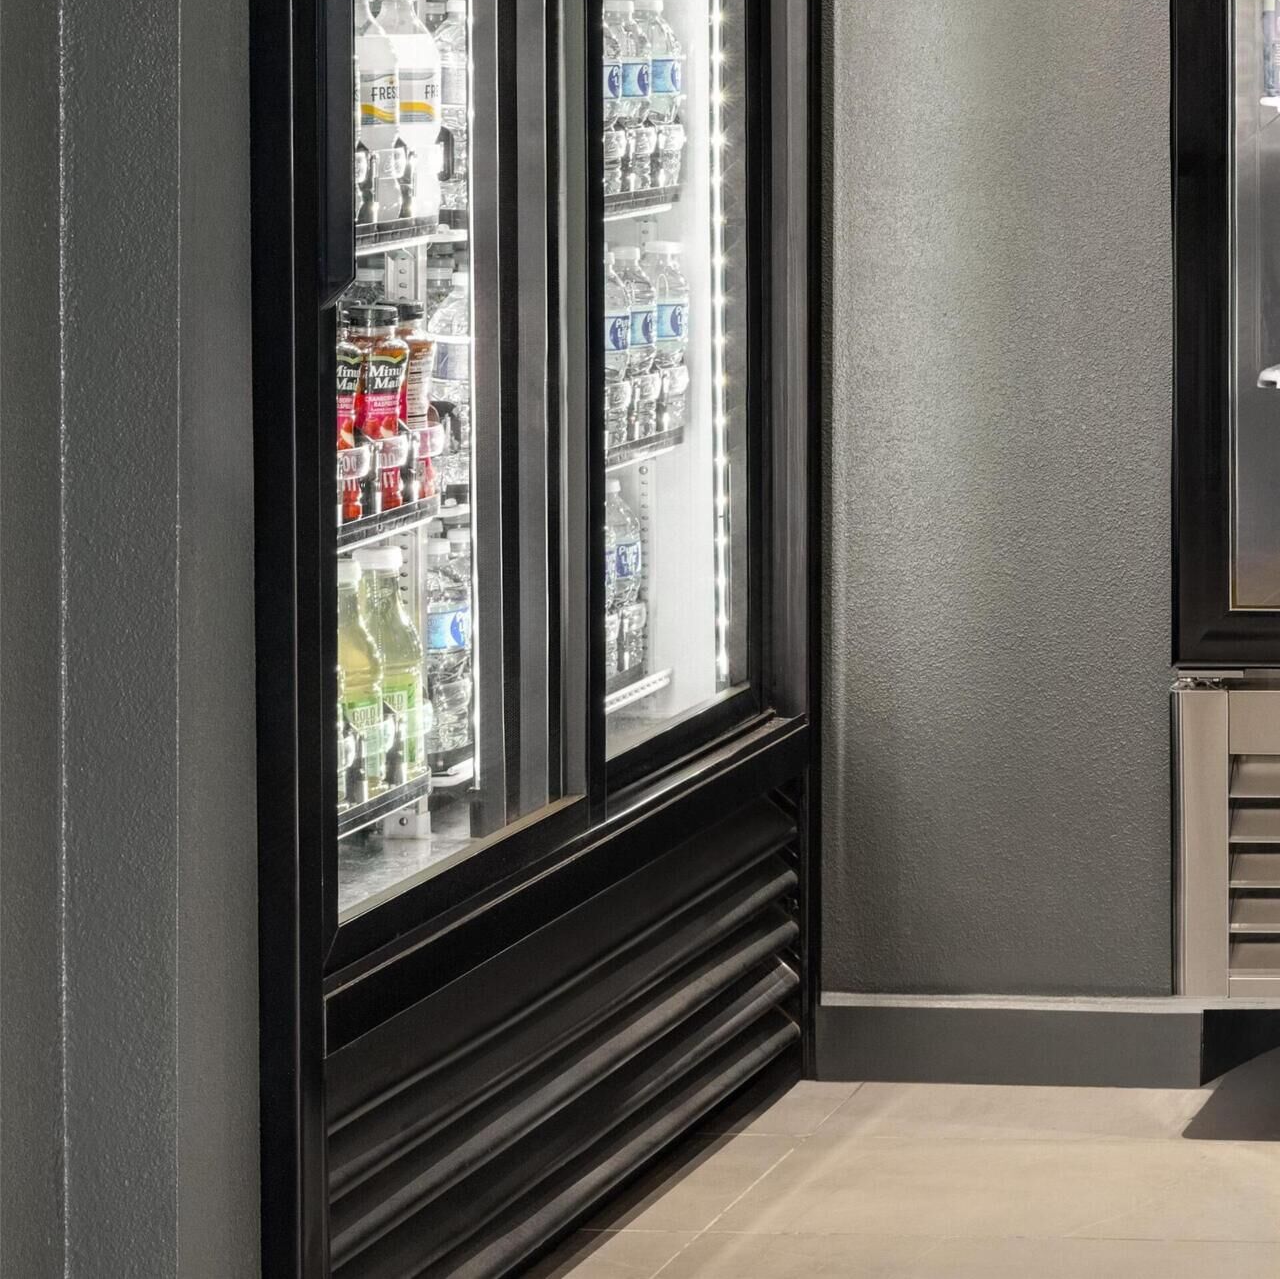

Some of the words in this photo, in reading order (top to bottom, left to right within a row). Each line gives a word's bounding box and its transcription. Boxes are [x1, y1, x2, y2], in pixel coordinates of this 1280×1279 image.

[371, 86, 398, 101] FRES
[369, 365, 402, 378] Minu
[374, 375, 401, 390] Mai
[383, 694, 404, 709] OLD
